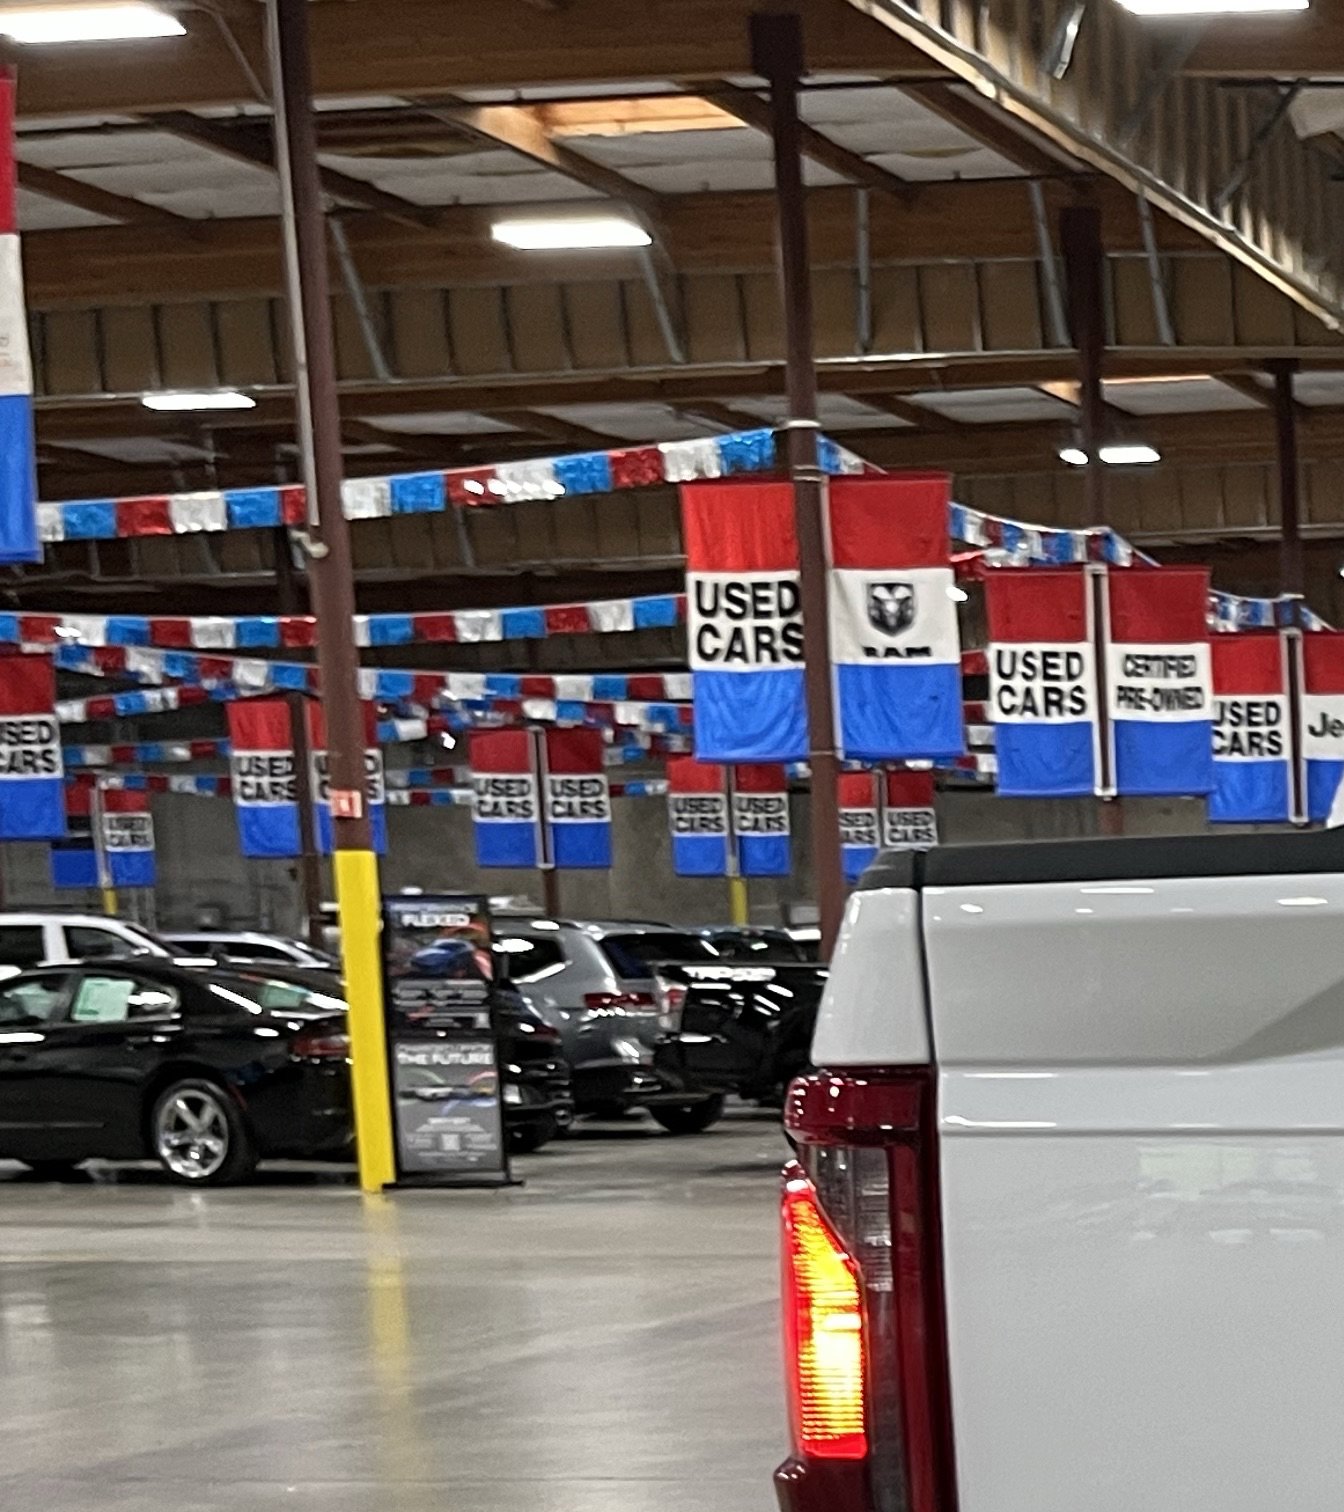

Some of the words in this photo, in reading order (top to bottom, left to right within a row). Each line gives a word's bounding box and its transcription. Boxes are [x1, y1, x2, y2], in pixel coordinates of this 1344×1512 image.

[695, 580, 801, 620] USED
[696, 622, 805, 663] CARS
[996, 650, 1084, 682] USED
[1123, 654, 1197, 678] CERTIFIED
[998, 685, 1087, 716] CARS
[1116, 685, 1204, 711] PRE-OWNED
[0, 720, 54, 745] SED
[476, 778, 531, 797] USED
[550, 778, 604, 798] USED
[477, 800, 533, 818] CARS
[551, 800, 607, 818] CARS
[839, 812, 875, 827] SED
